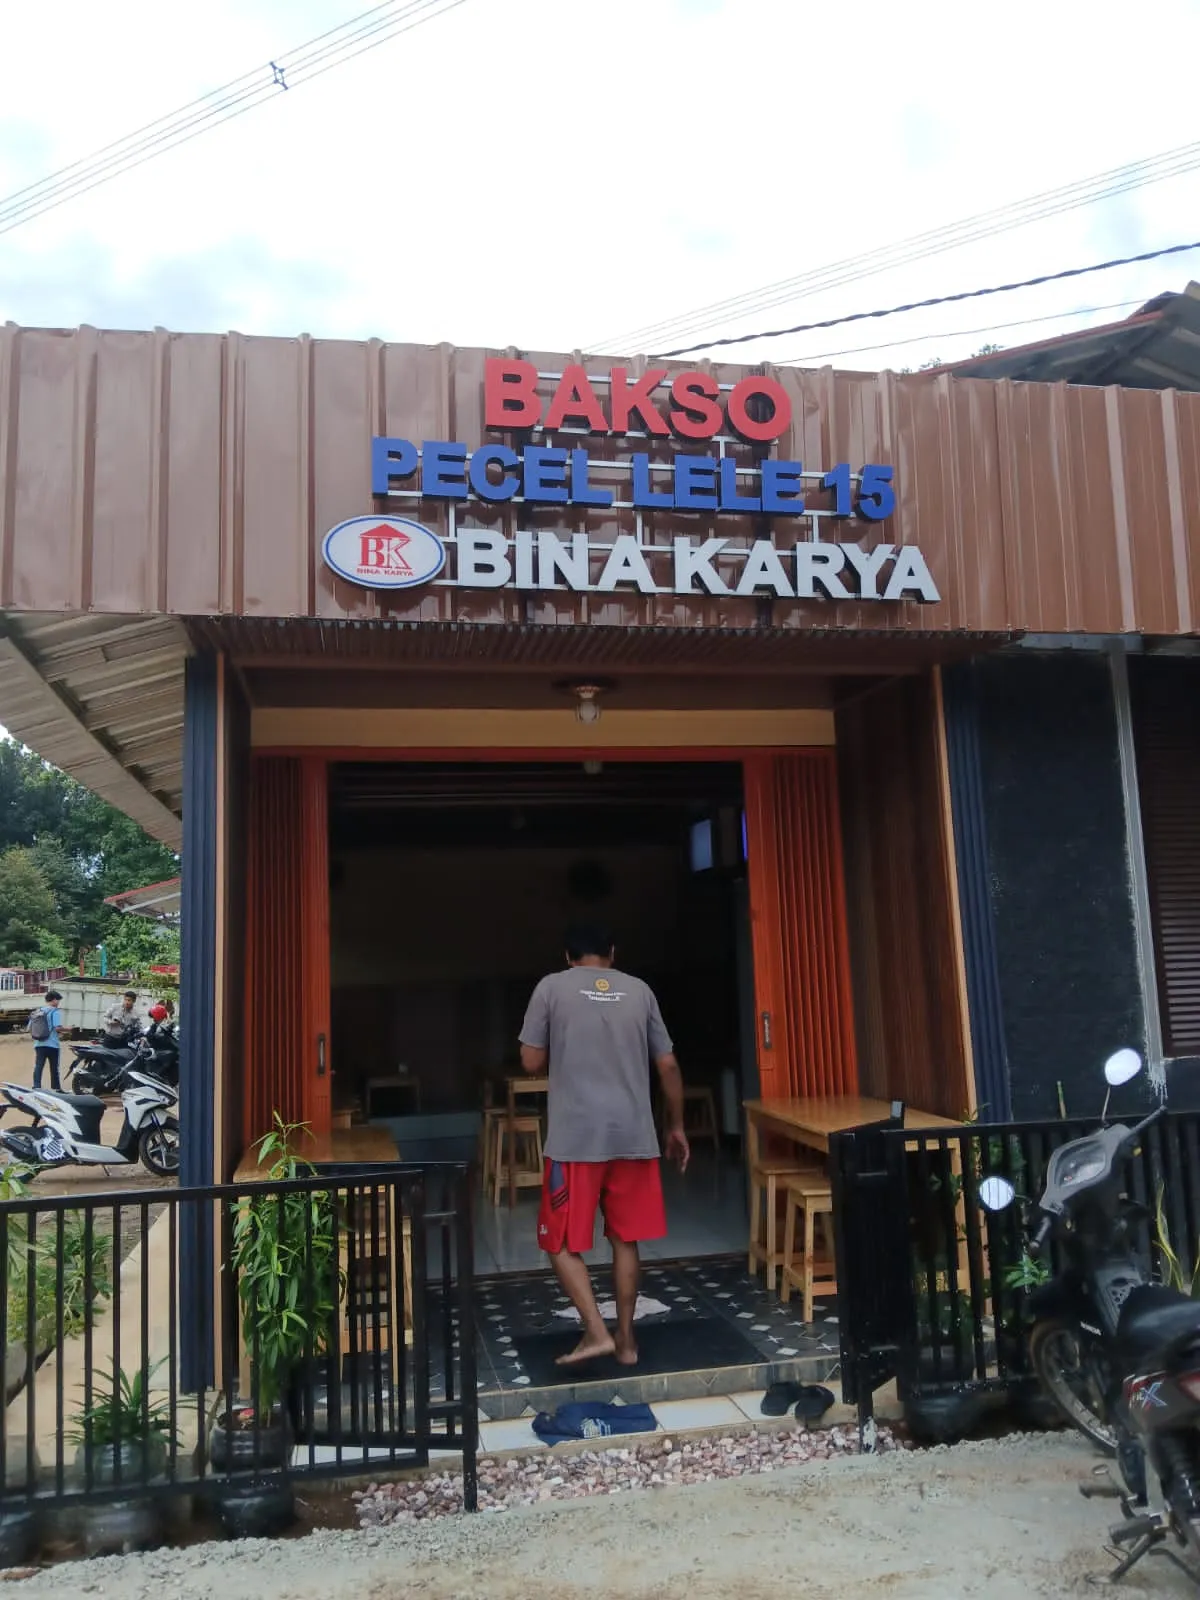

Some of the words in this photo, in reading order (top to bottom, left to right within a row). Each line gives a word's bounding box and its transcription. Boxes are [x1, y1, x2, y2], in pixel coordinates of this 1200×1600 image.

[484, 357, 791, 441] BAKSO
[371, 436, 613, 505] PECEL
[632, 452, 804, 514] LELE
[822, 463, 896, 520] 15
[359, 536, 412, 569] BK
[456, 528, 657, 593] BINA
[673, 536, 941, 602] KARYA
